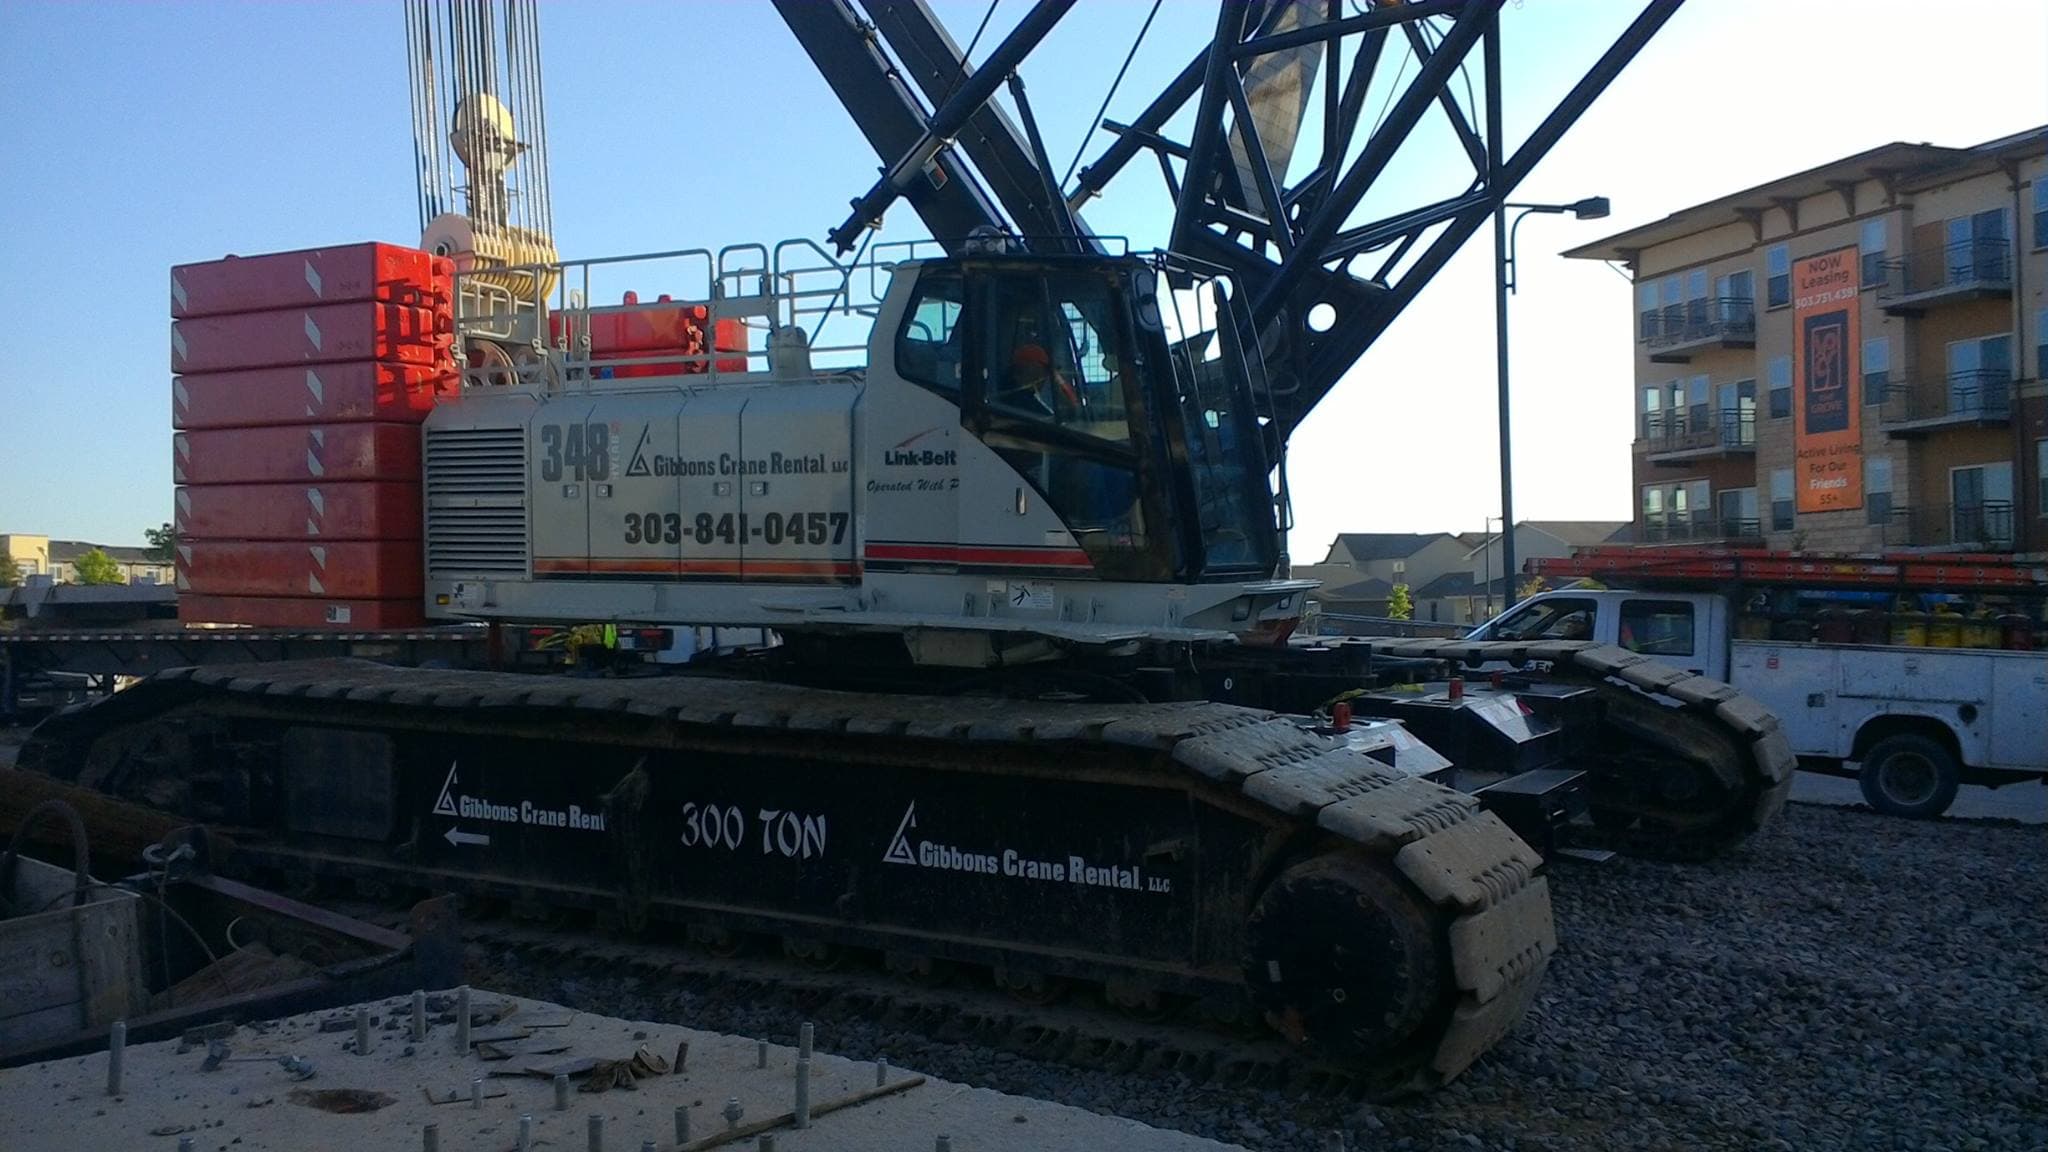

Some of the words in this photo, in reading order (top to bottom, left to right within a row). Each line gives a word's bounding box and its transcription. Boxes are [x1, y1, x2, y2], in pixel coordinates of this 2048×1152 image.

[1809, 255, 1842, 272] NOW
[1801, 270, 1850, 289] Leasing
[541, 423, 609, 482] 348
[885, 450, 957, 466] Link-Belt
[1798, 446, 1827, 458] Active
[654, 455, 715, 477] Gibbons
[719, 453, 768, 475] Crane
[1810, 463, 1825, 474] For
[1828, 461, 1847, 472] Our
[867, 480, 913, 492] Operated
[917, 478, 944, 491] With
[1810, 477, 1848, 490] Friends
[624, 512, 849, 545] 303-841-0457
[459, 795, 518, 823] Gibbons
[521, 800, 567, 828] Crane
[680, 801, 744, 851] 300
[758, 808, 826, 860] TON
[919, 840, 999, 875] Gibbons
[1002, 849, 1065, 882] Crane
[1147, 876, 1170, 893] LLC
